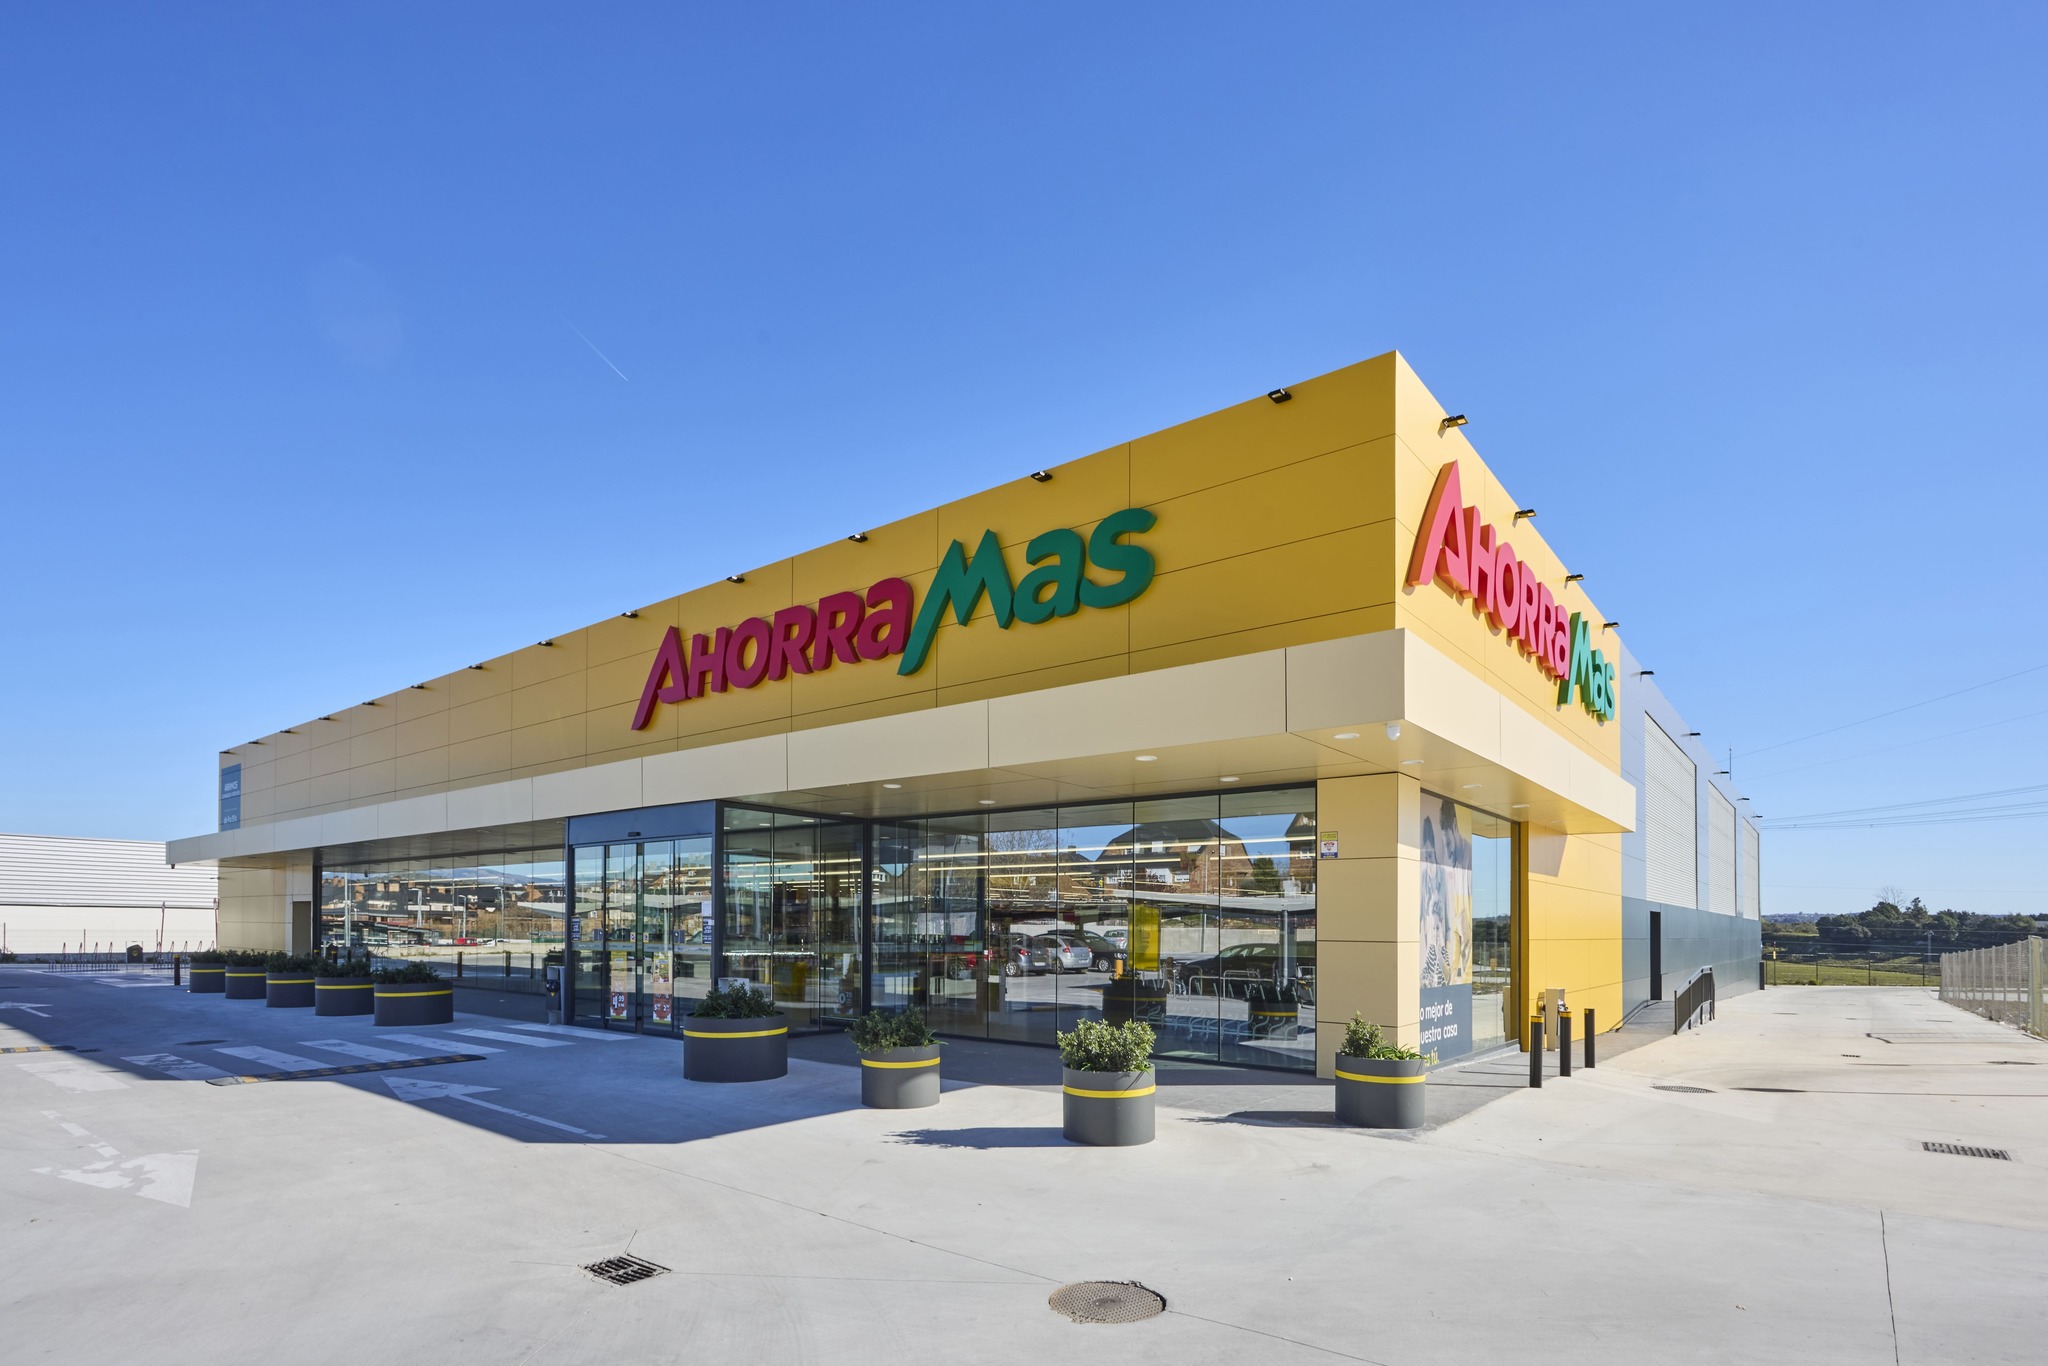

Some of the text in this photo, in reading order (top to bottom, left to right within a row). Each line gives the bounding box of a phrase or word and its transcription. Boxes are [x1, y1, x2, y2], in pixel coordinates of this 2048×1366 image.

[1425, 1001, 1444, 1022] mejor
[1444, 999, 1453, 1016] de
[1420, 1023, 1458, 1045] uestra casa
